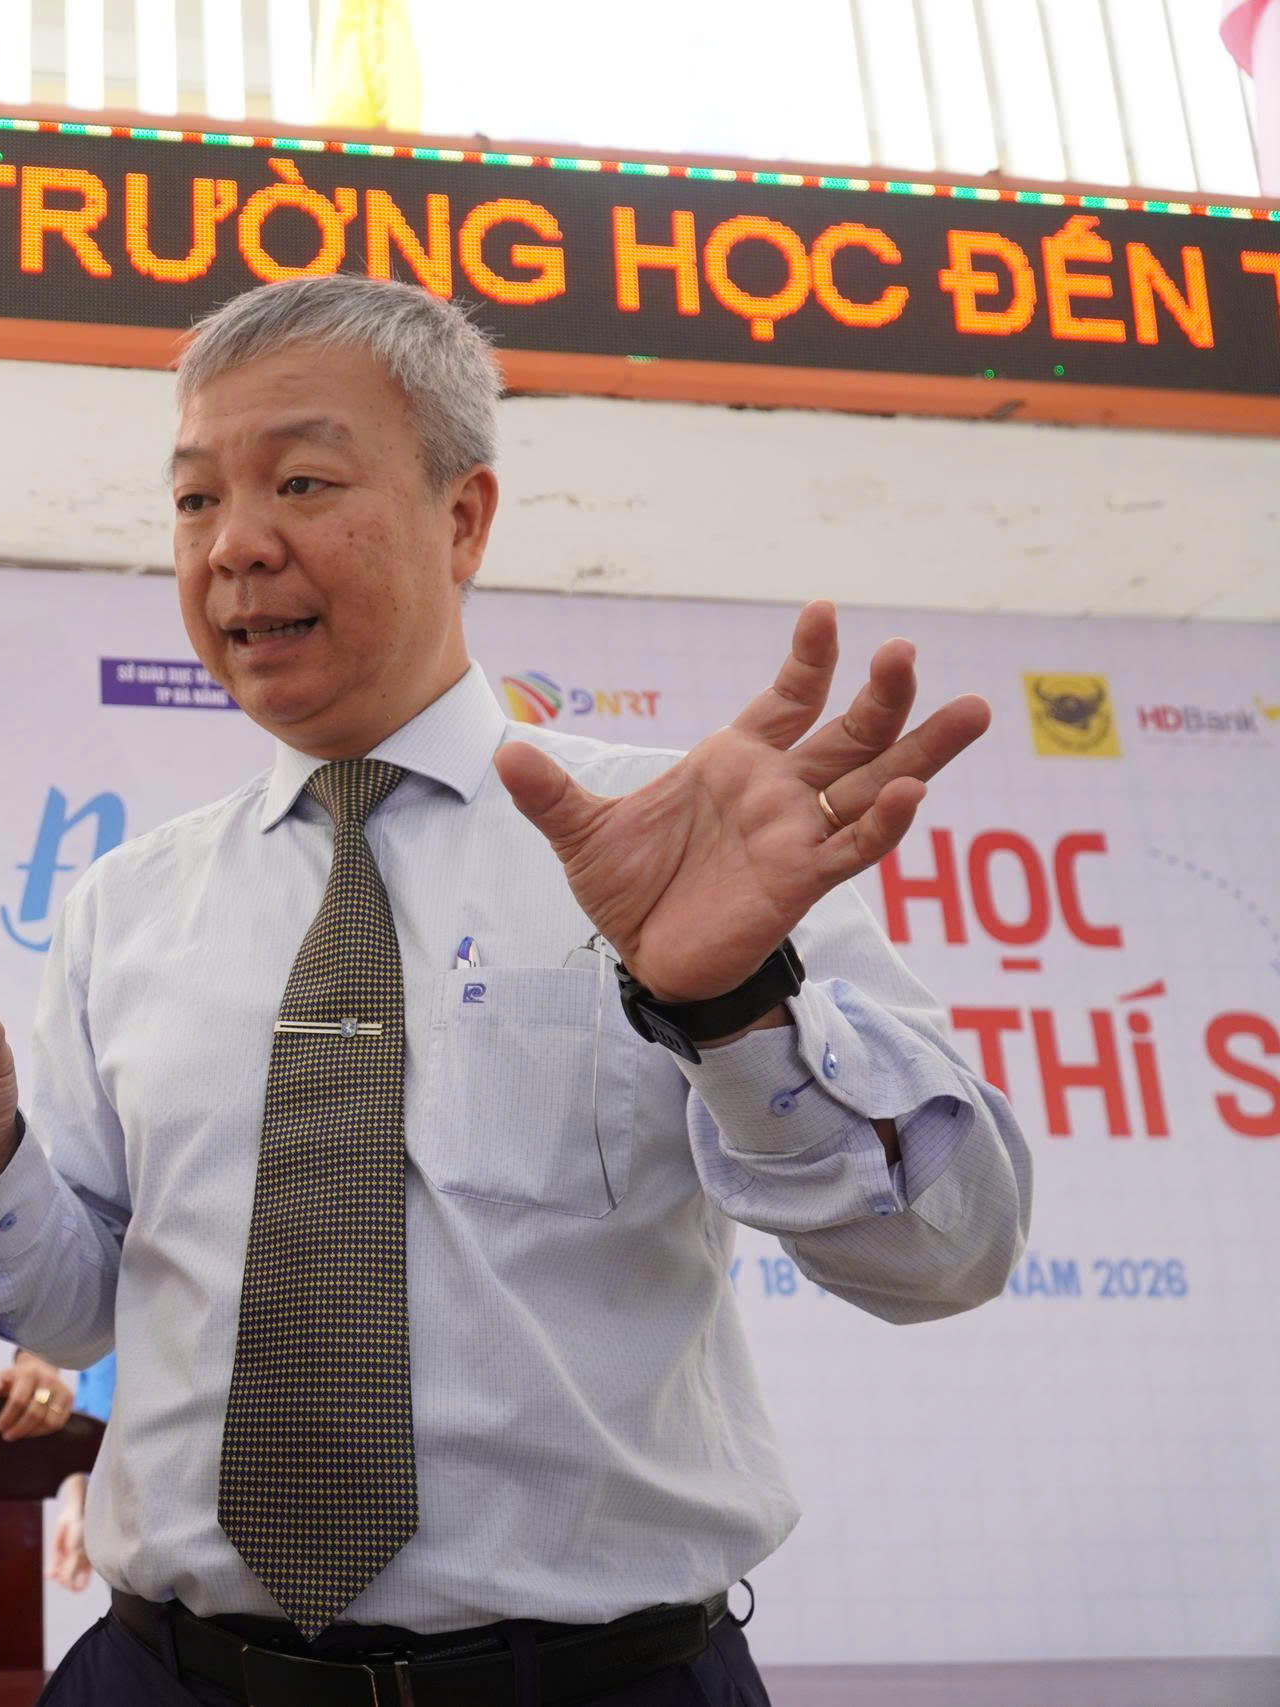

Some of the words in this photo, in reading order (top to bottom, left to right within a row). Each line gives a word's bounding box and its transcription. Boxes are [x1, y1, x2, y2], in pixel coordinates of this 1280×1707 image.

[611, 205, 909, 343] HỌC
[938, 215, 1216, 350] ĐẾN
[1137, 703, 1259, 734] HDBank
[878, 827, 1125, 973] HỌC
[759, 1256, 797, 1297] 18
